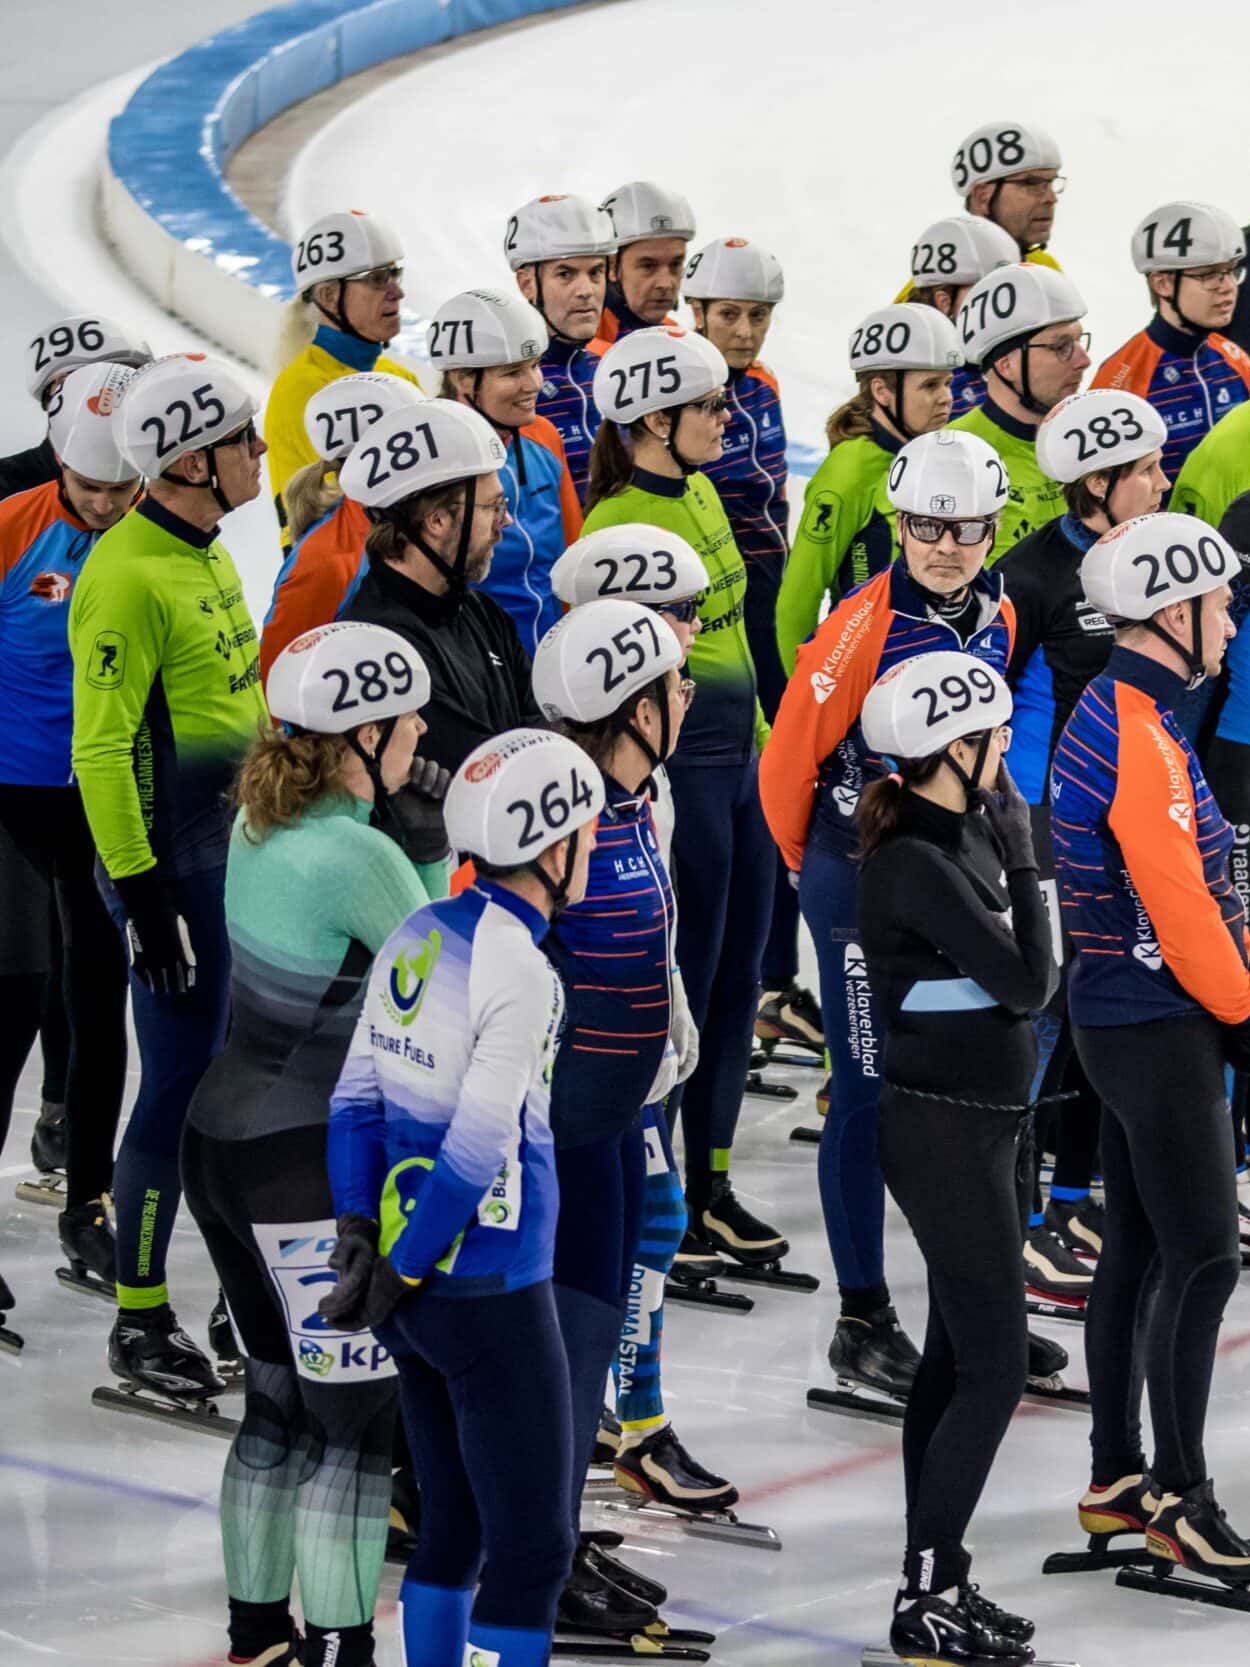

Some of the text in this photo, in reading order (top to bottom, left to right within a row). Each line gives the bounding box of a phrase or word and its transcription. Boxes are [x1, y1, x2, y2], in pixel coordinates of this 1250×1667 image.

[953, 129, 1025, 188] 308
[297, 231, 345, 273] 263
[911, 242, 958, 276] 228
[1141, 218, 1193, 259] 14
[430, 320, 474, 357] 271
[850, 322, 911, 359] 280
[959, 282, 1017, 345] 270
[30, 320, 105, 372] 296
[608, 355, 682, 410] 275
[141, 384, 226, 459] 225
[1063, 407, 1144, 462] 283
[360, 422, 440, 489] 281
[594, 550, 677, 596] 223
[1131, 536, 1226, 599] 200
[822, 599, 874, 674] Klaverblad
[1083, 616, 1107, 627] REG
[323, 651, 413, 713] 289
[586, 617, 662, 694] 257
[912, 667, 996, 727] 299
[506, 768, 593, 849] 264
[846, 980, 861, 1060] verzekeringen
[855, 980, 880, 1078] Klaverblad
[341, 1342, 389, 1371] kp
[916, 1547, 935, 1594] VIKING
